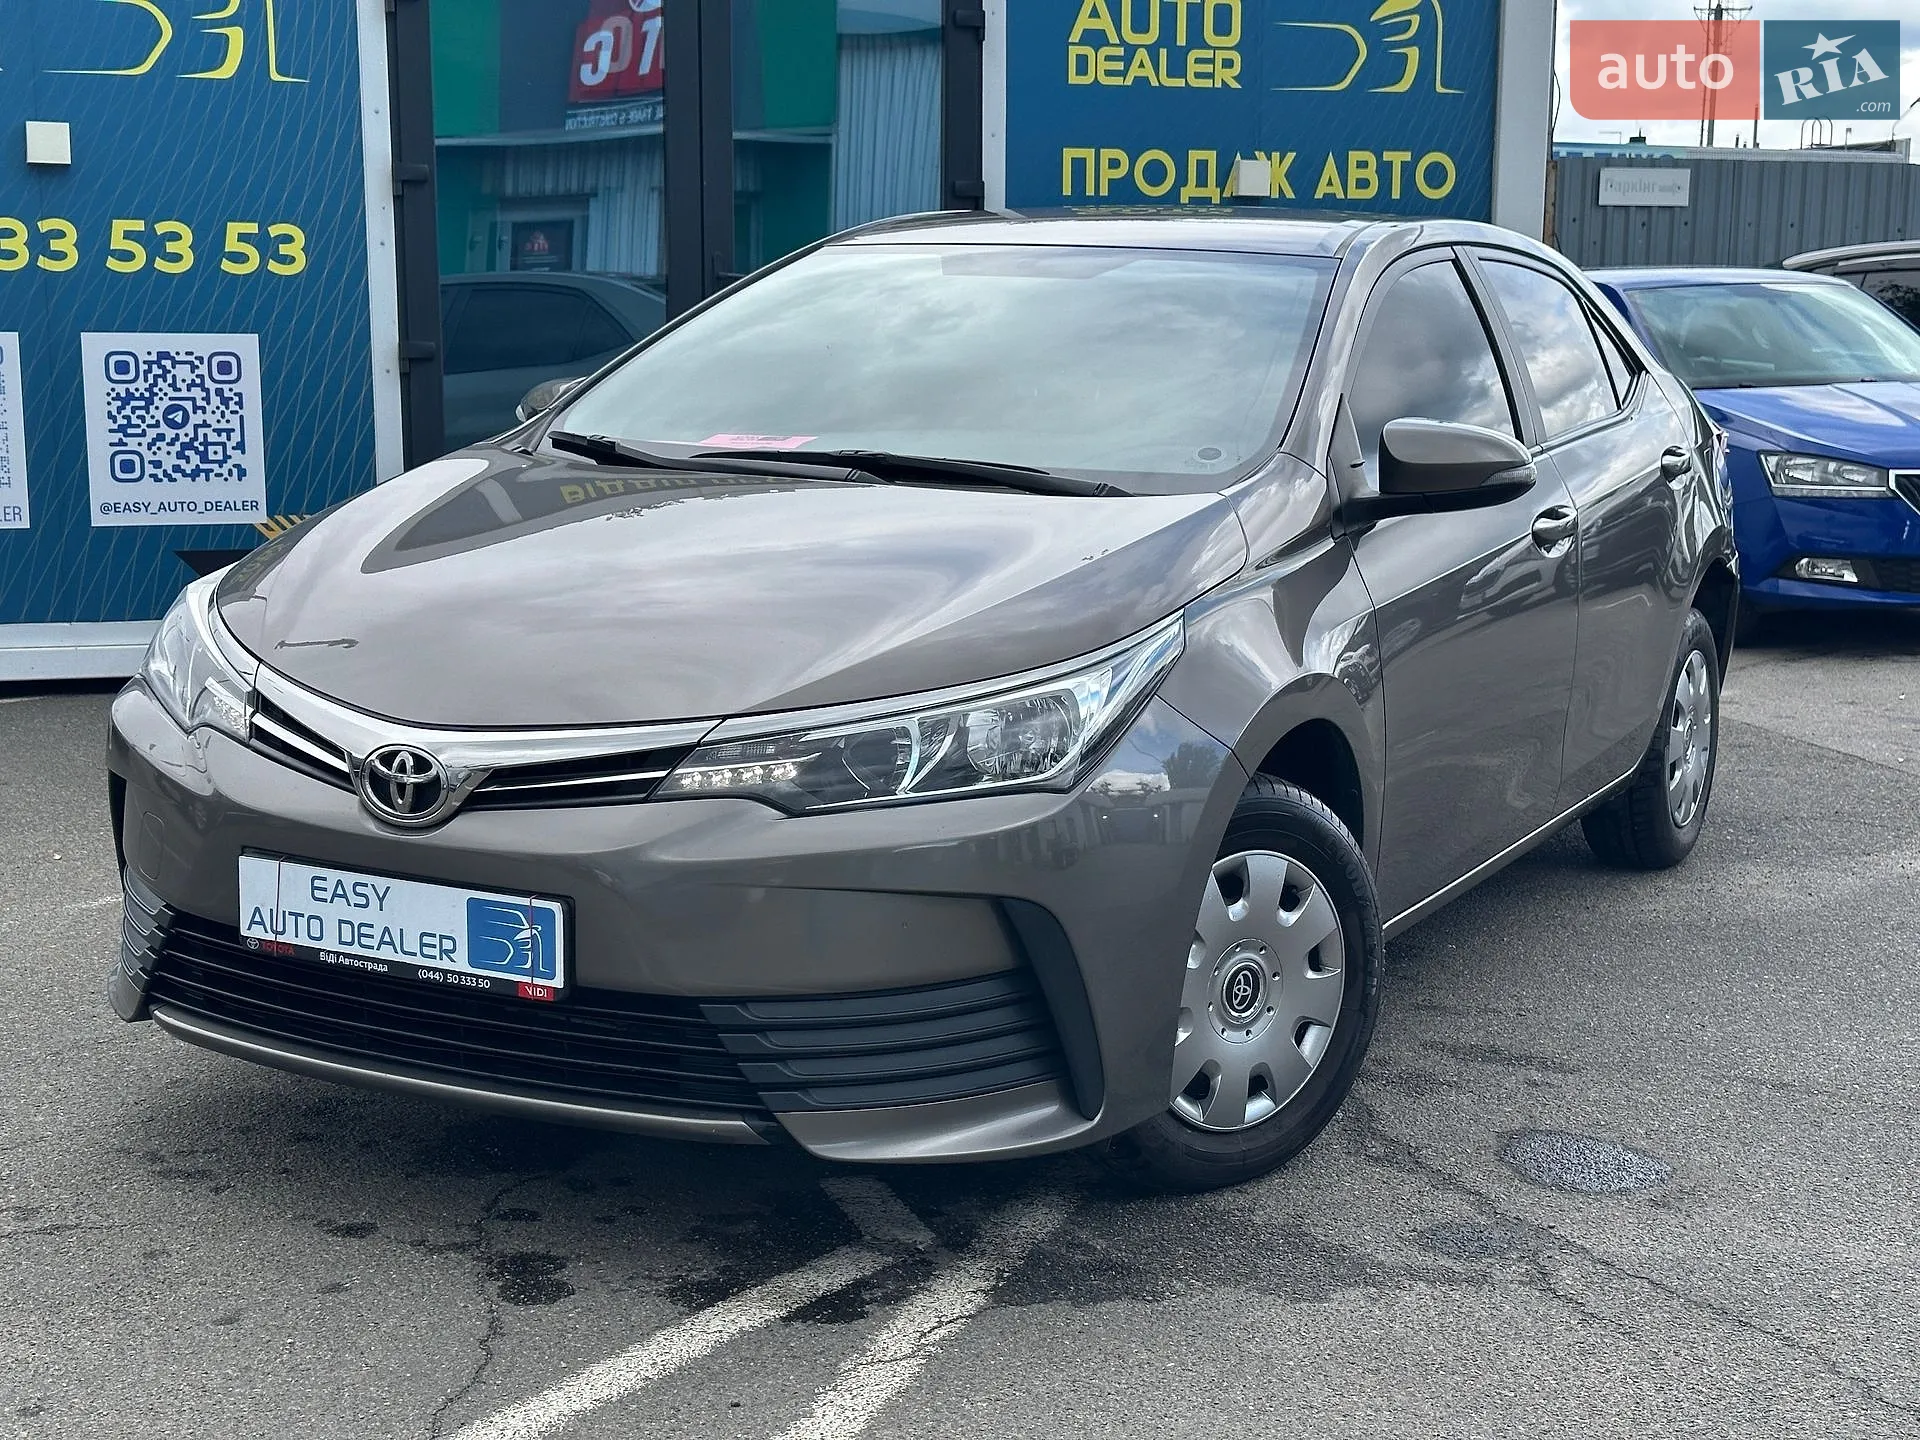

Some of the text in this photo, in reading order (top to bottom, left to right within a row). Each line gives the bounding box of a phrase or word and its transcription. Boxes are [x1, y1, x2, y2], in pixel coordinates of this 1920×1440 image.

[1068, 0, 1242, 47] AUTO
[1068, 45, 1242, 89] DEALER
[1314, 150, 1457, 200] АВТО
[105, 219, 194, 273] 53
[220, 222, 308, 276] 53
[99, 499, 260, 516] @EASY_AUTO_DEALER
[310, 875, 391, 911] EASY
[247, 906, 457, 963] AUTO DEALER
[339, 955, 389, 972] Автострада
[418, 968, 444, 983] (044)
